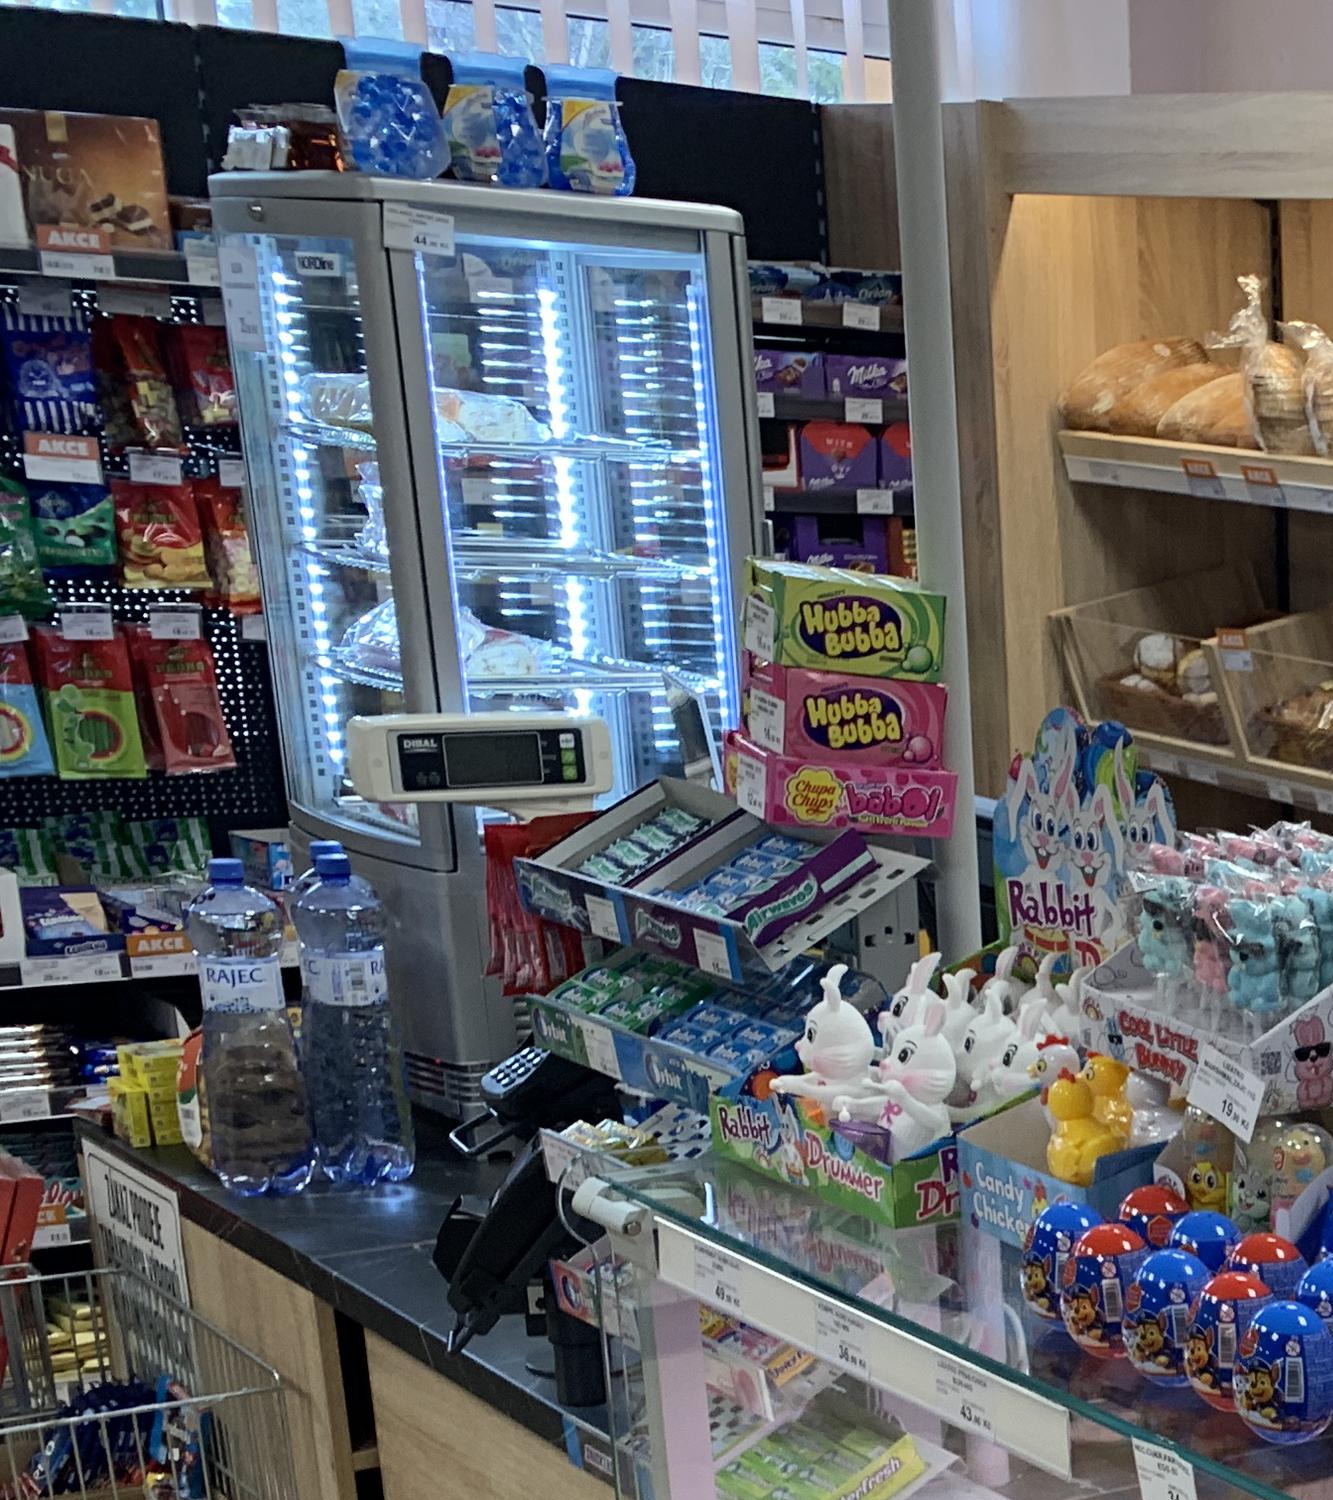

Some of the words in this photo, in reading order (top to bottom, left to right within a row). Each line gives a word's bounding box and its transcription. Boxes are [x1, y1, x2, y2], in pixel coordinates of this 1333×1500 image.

[48, 231, 100, 248] AKCE
[848, 366, 888, 384] Milka
[37, 437, 91, 457] AKCE
[803, 601, 881, 634] Hubba
[825, 621, 900, 658] Bubba
[806, 695, 881, 728] Hubba
[404, 738, 438, 750] DIBAL
[828, 713, 901, 749] Bubba
[794, 795, 836, 815] Chups
[795, 779, 836, 798] Chupa
[1007, 878, 1096, 937] Rabbit
[137, 936, 184, 953] AKCE
[206, 966, 266, 985] RAJEC
[1119, 1009, 1154, 1042] COOL
[1154, 1022, 1199, 1062] LITTLE
[1135, 1041, 1187, 1086] BUNNY
[719, 1105, 772, 1146] Rabbit
[805, 1129, 886, 1203] Drummer
[975, 1161, 1025, 1207] Candy
